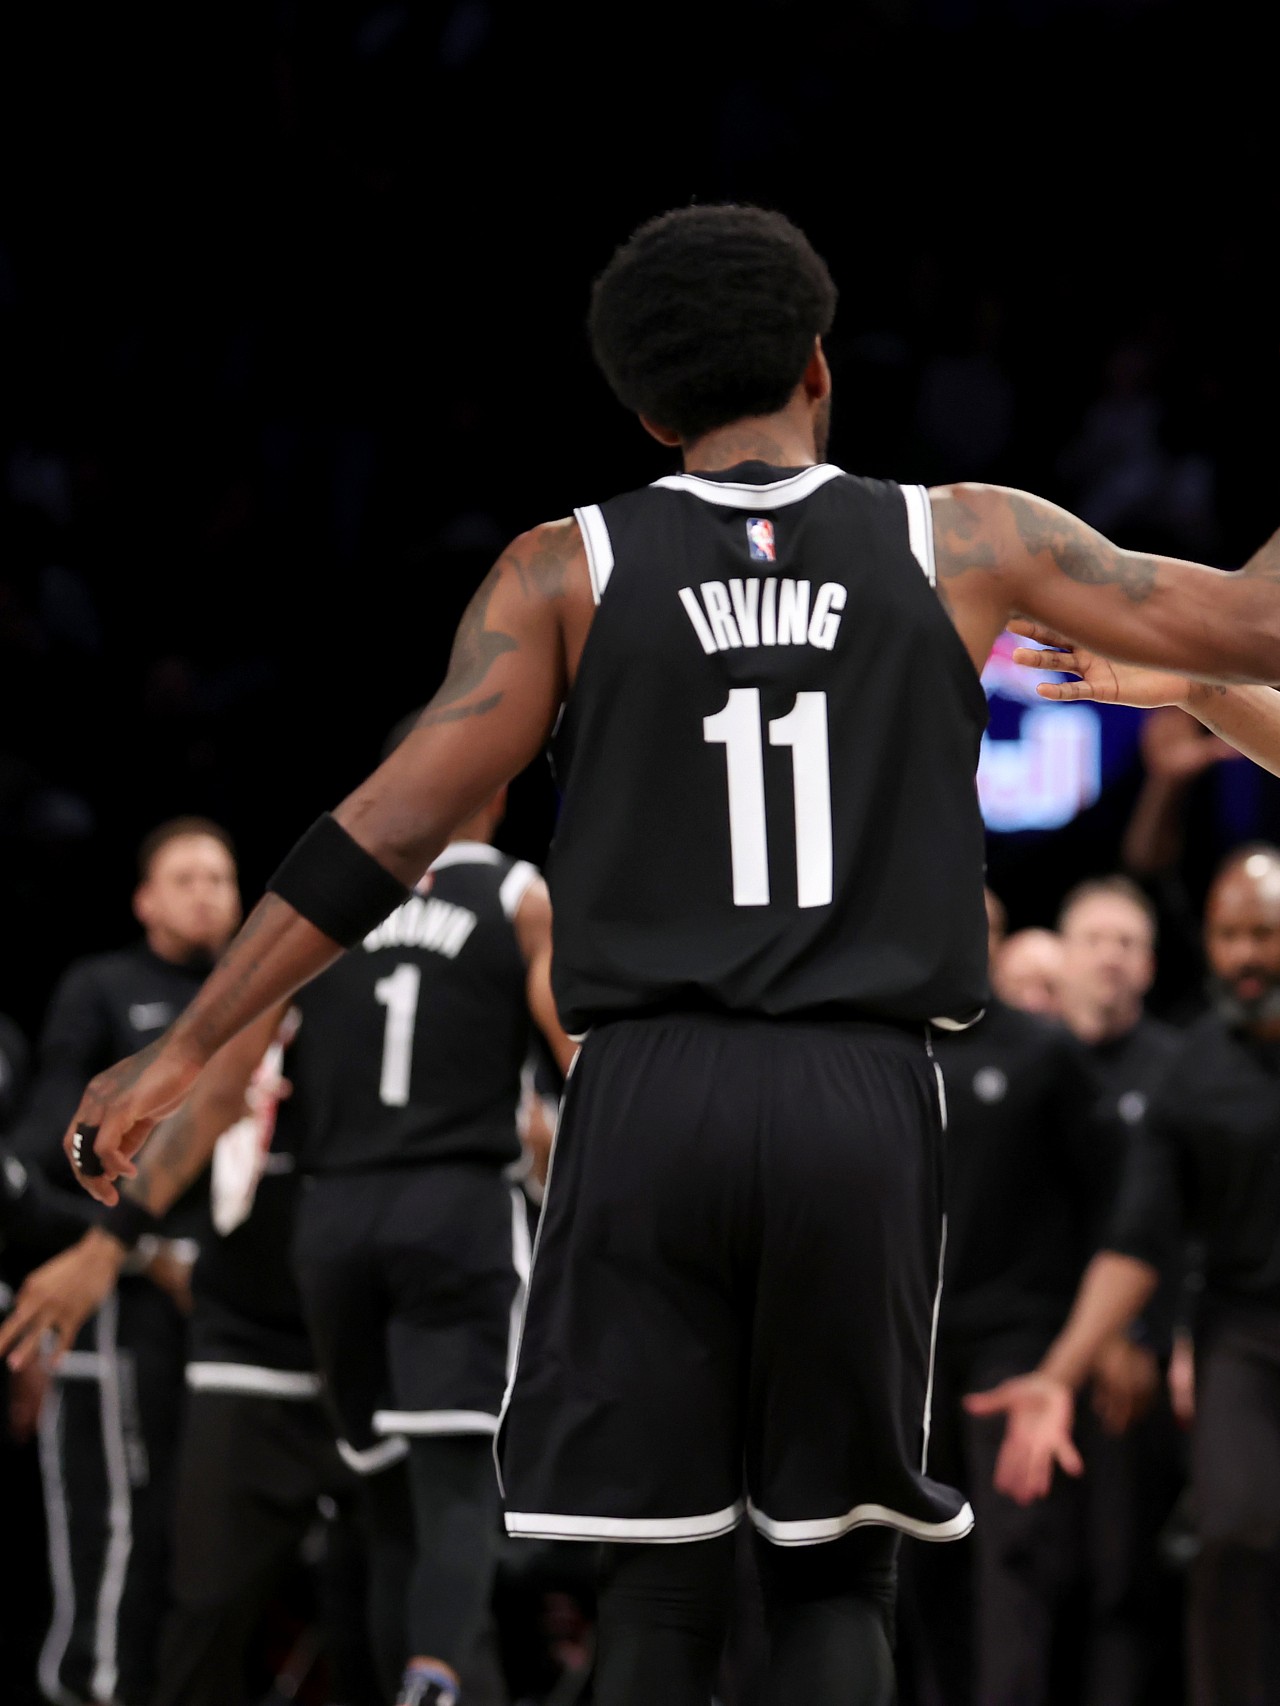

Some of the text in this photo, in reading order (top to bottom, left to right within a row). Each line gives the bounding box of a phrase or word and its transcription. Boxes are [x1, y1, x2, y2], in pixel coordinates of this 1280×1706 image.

[677, 577, 848, 655] IRVING
[702, 687, 833, 909] 11
[374, 963, 421, 1107] 1
